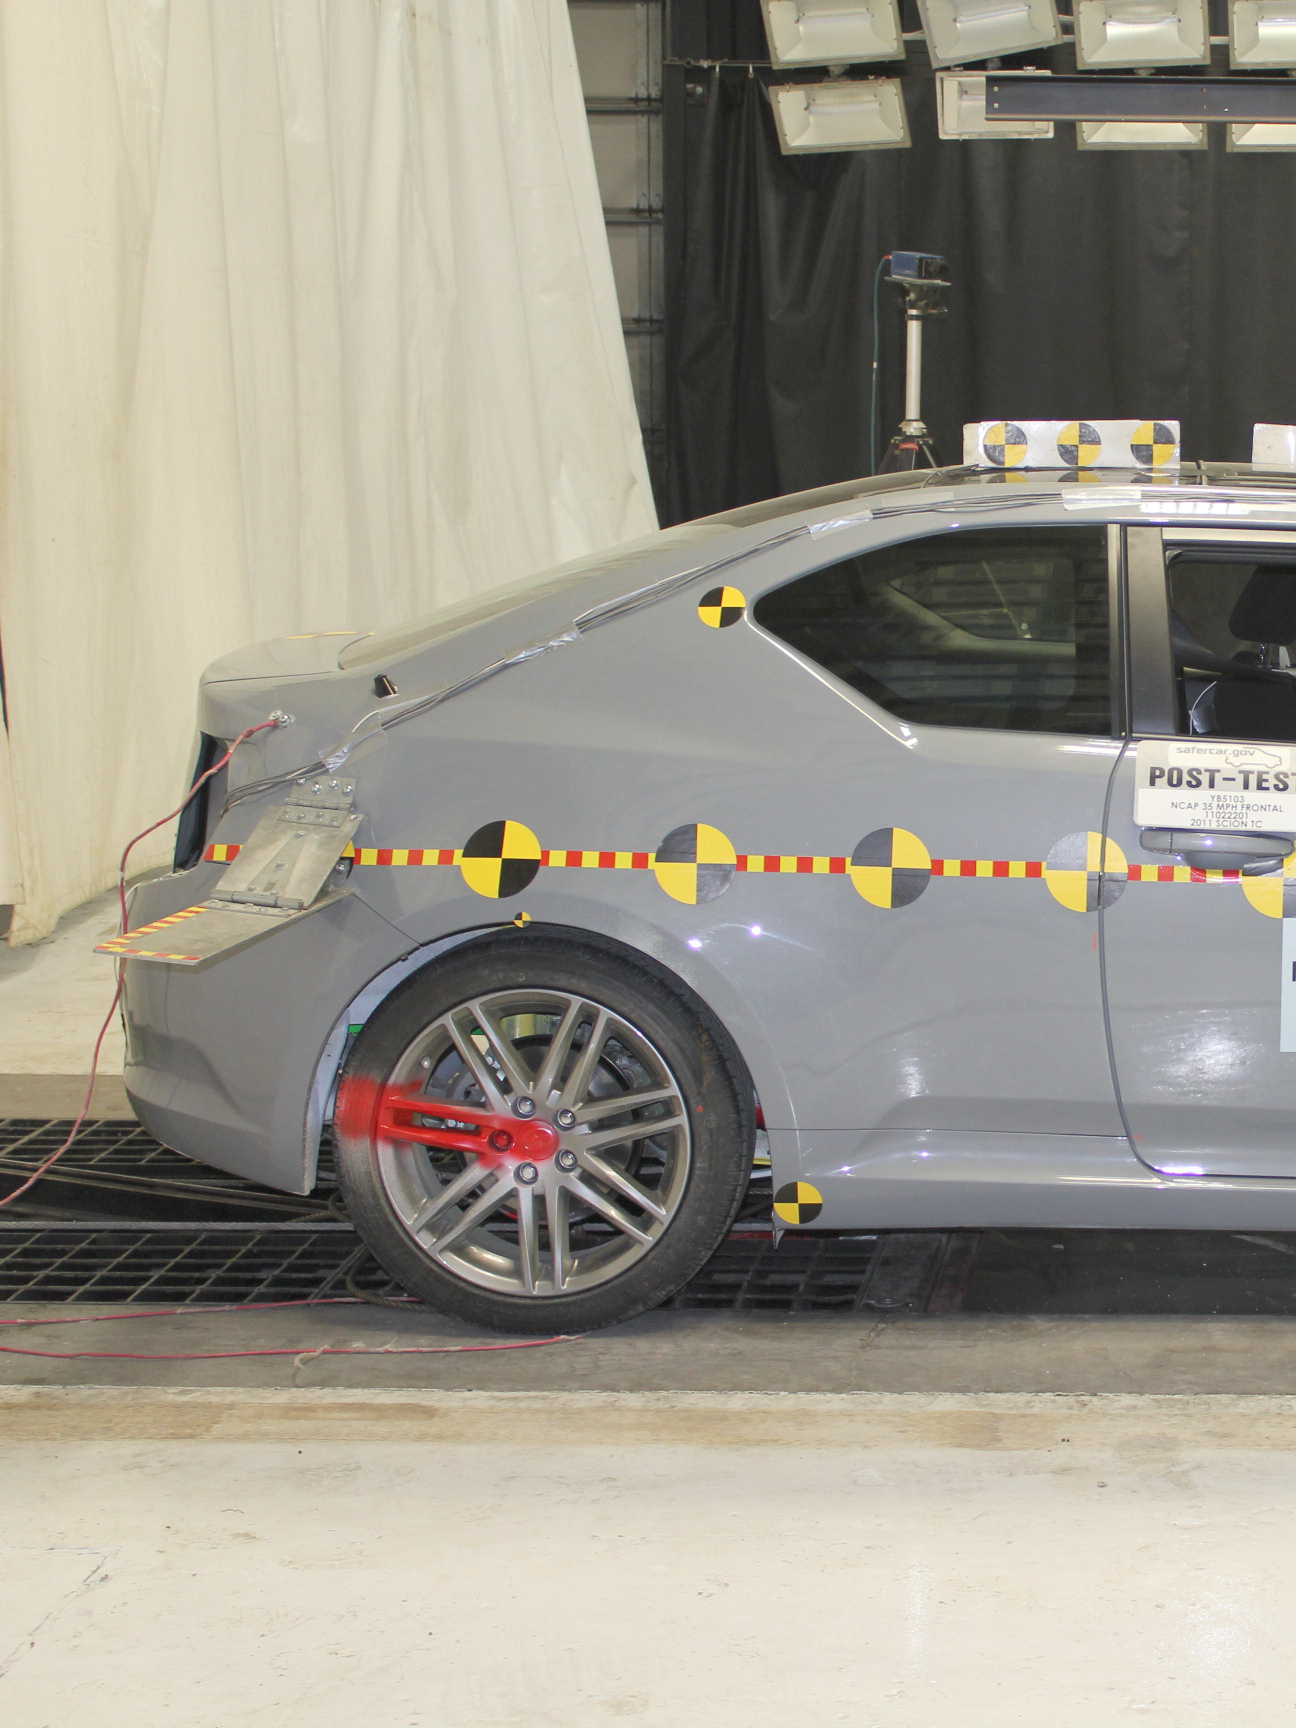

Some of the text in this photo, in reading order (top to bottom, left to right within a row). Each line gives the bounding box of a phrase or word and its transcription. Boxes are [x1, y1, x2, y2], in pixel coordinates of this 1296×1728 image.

[1176, 746, 1256, 758] safercar.gov
[1210, 795, 1245, 803] YB5103
[1171, 801, 1284, 813] NCAP 35 MPH FRONTAL
[1205, 811, 1249, 820] 11022201
[1190, 819, 1263, 829] 2011 SCION TC
